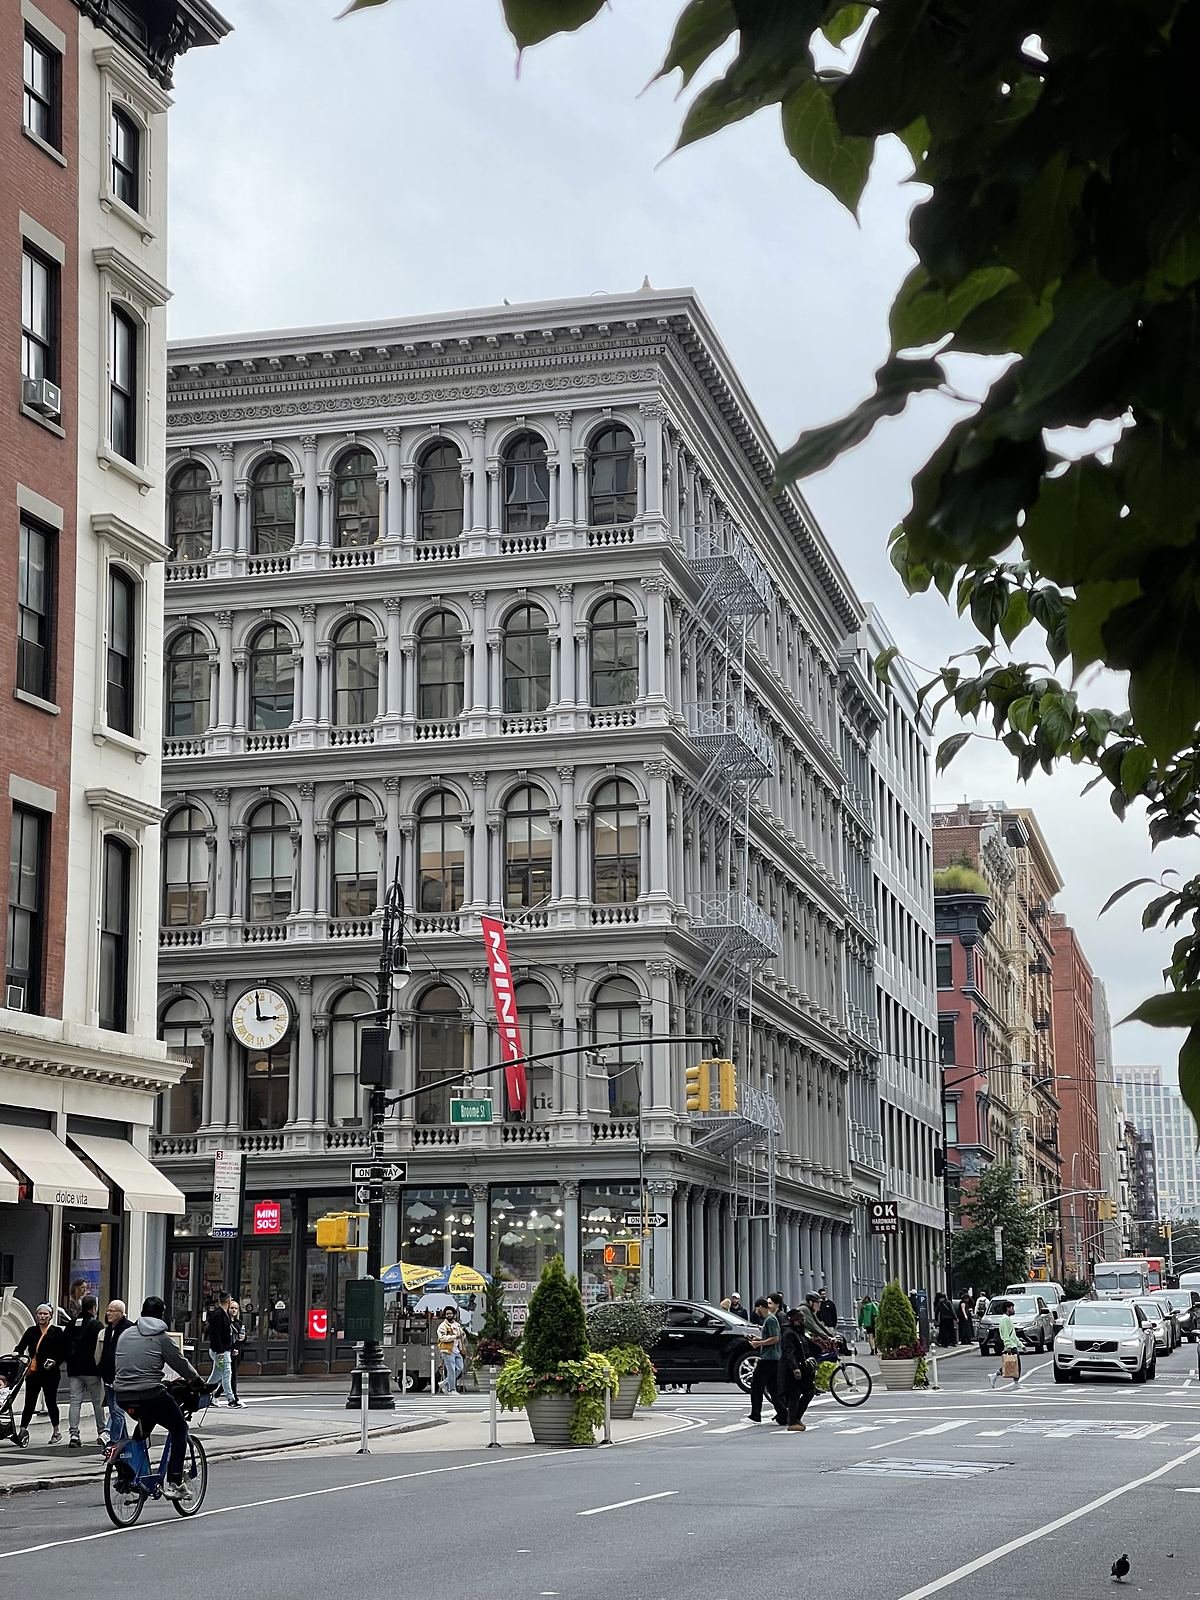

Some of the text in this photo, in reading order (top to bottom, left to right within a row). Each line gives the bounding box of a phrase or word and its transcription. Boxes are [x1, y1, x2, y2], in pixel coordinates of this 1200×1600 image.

[489, 931, 521, 1101] MINI
[460, 1105, 486, 1118] Broome St
[383, 1168, 398, 1177] WAY
[56, 1190, 88, 1205] dolce vita
[257, 1210, 277, 1218] MINI
[873, 1204, 894, 1216] OK
